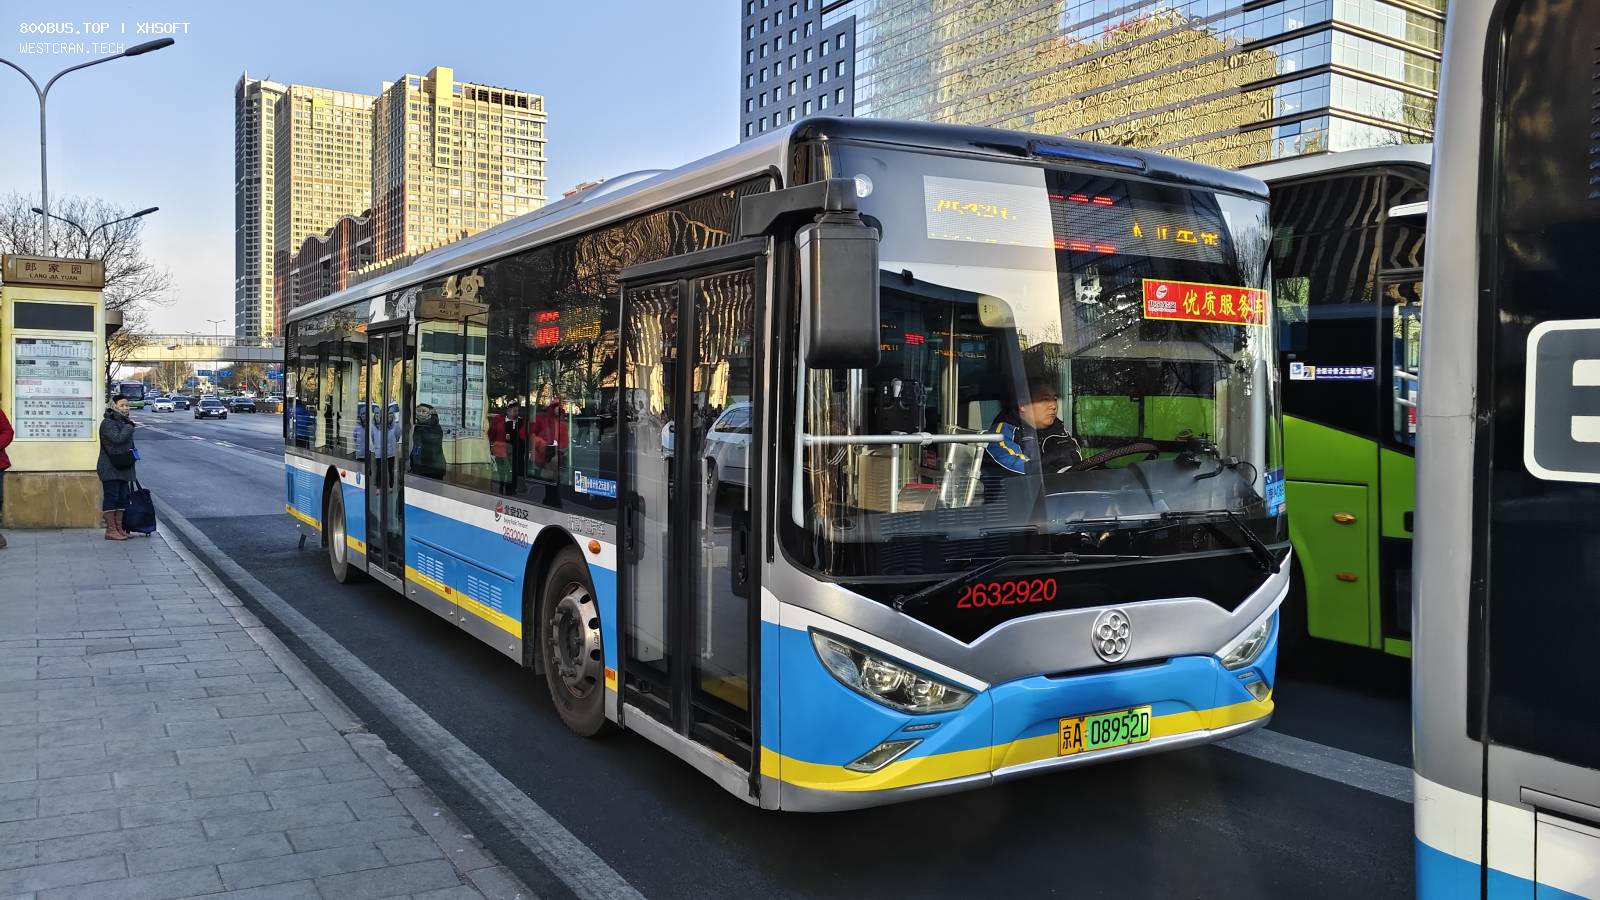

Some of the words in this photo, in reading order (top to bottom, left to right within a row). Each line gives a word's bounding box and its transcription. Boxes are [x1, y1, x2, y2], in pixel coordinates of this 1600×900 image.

[1182, 289, 1264, 319] 优质服务车
[957, 578, 1057, 608] 2632920
[1091, 712, 1149, 745] 08952D
